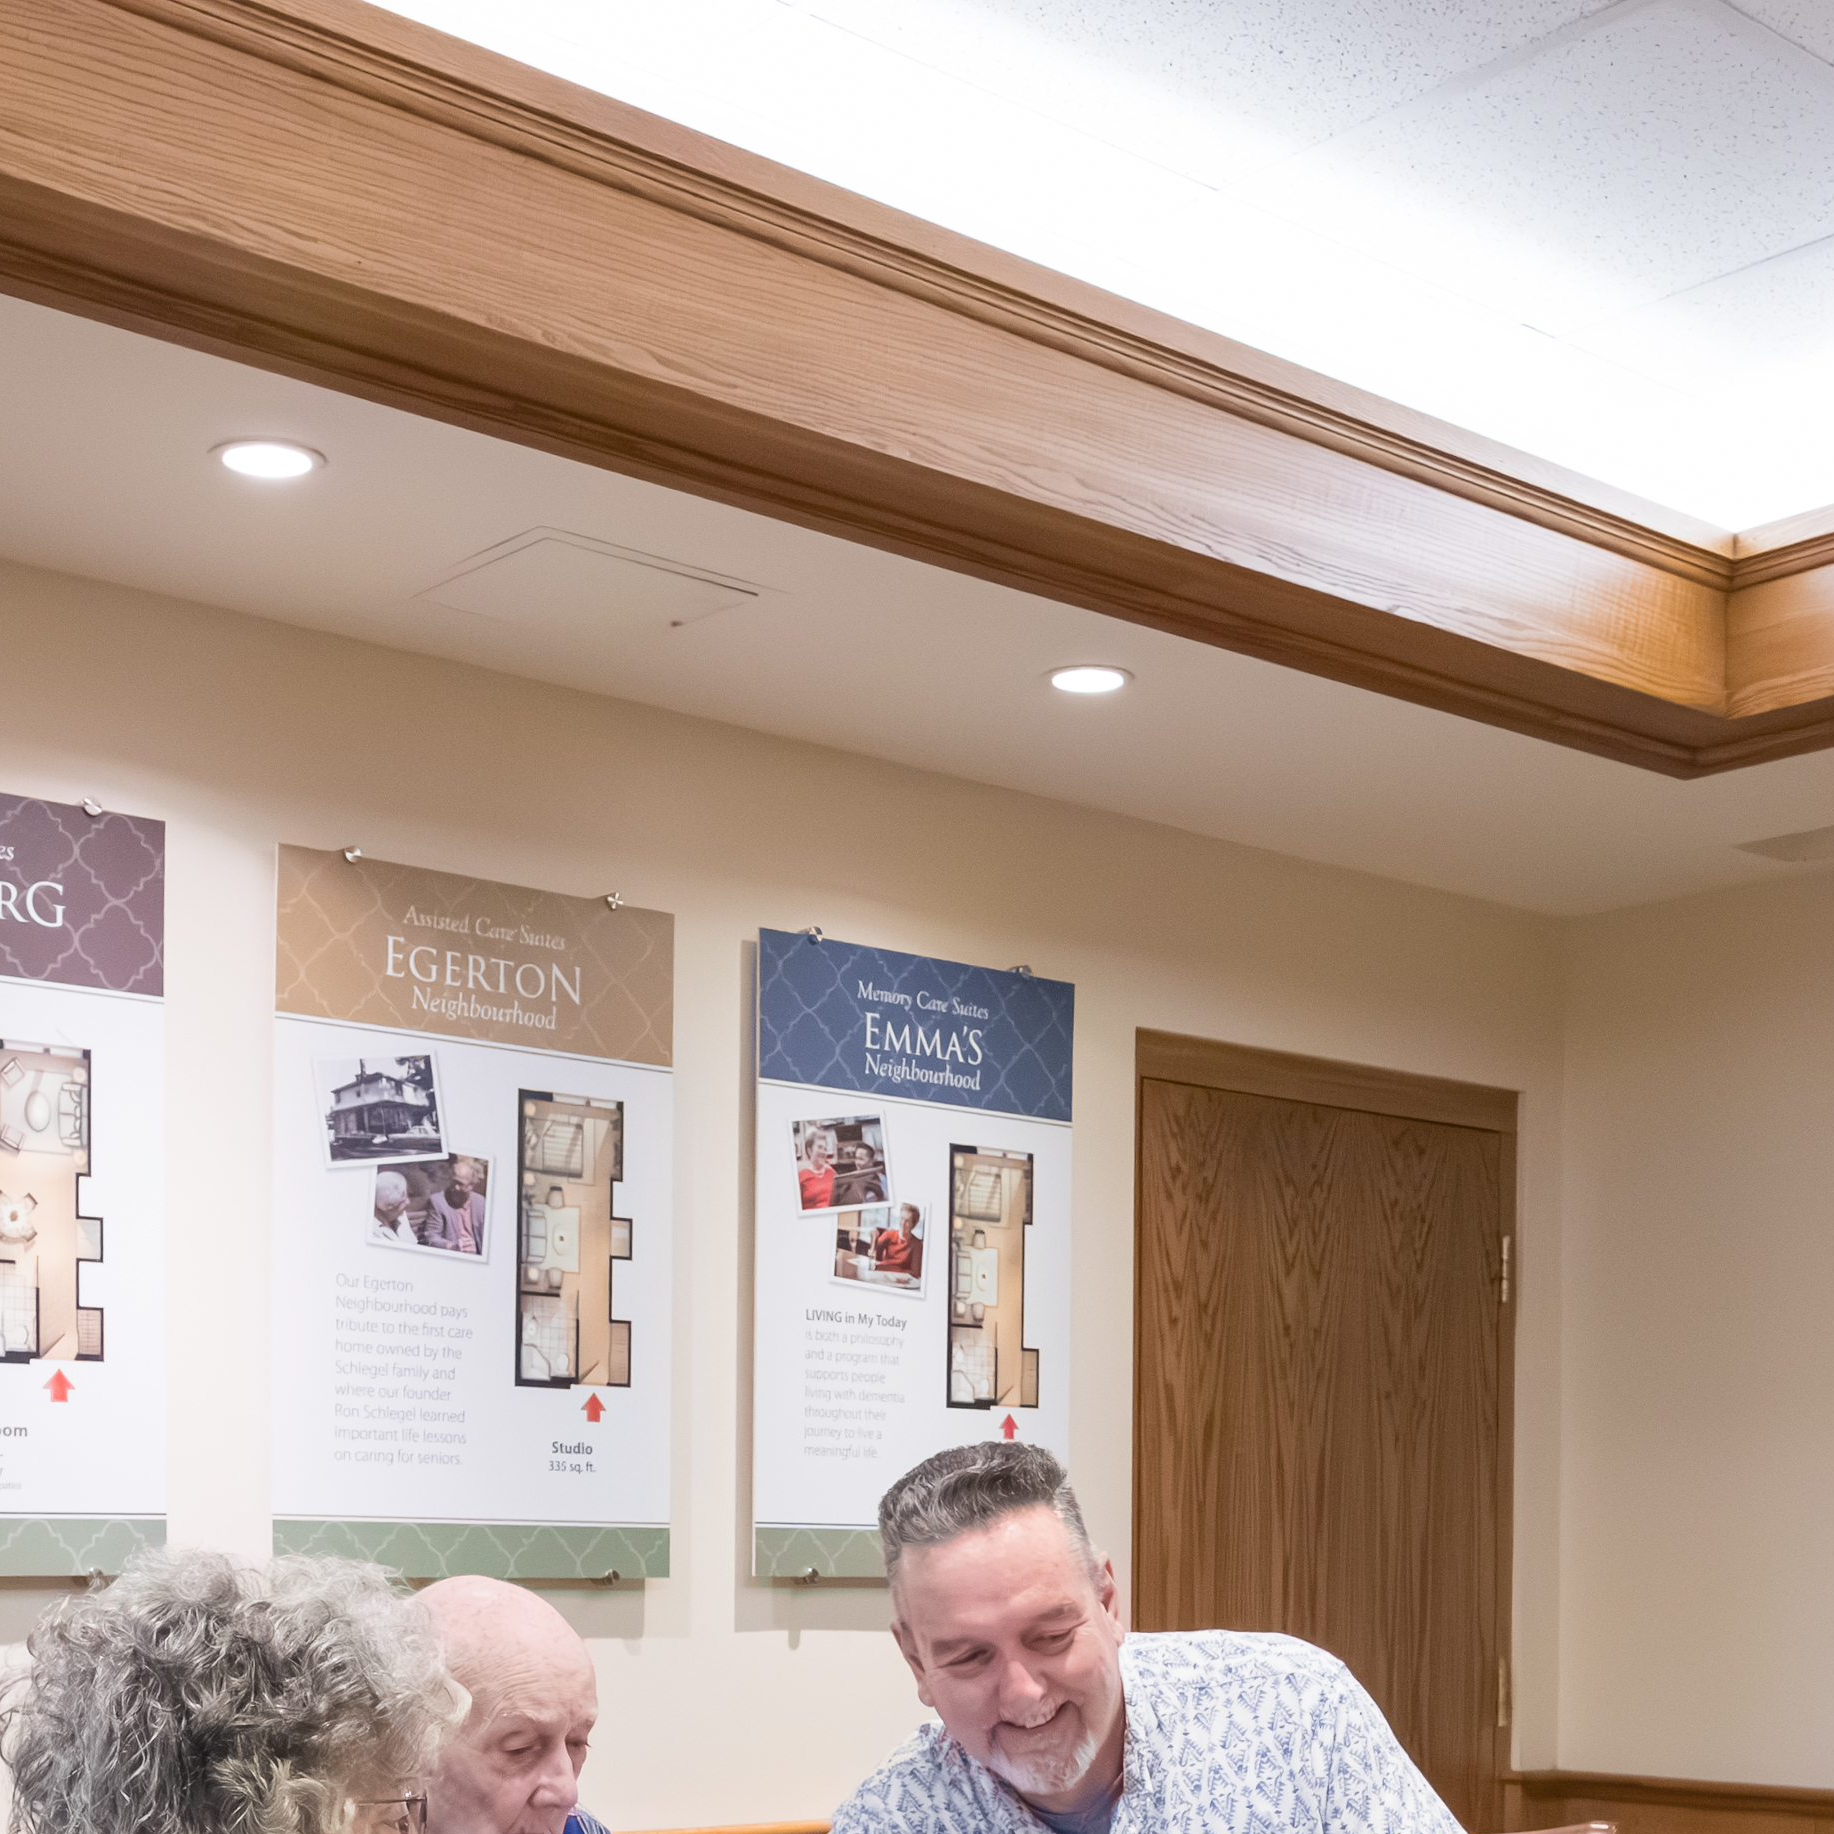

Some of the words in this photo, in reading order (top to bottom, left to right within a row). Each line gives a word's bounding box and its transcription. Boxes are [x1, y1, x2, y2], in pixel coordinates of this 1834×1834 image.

[403, 905, 469, 934] Assisted
[475, 917, 516, 942] Care
[519, 924, 567, 951] Suites
[386, 935, 582, 1006] EGERTON
[412, 986, 557, 1031] Neighbourhood
[857, 980, 913, 1010] Memory
[916, 990, 948, 1013] Care
[952, 997, 990, 1020] Suites
[864, 1011, 984, 1066] EMMA'S
[865, 1052, 982, 1091] Neighbourhood
[336, 1273, 359, 1289] Our
[363, 1275, 413, 1293] Egerton
[335, 1295, 437, 1316] Neighbourhood
[441, 1304, 468, 1321] pays
[336, 1318, 378, 1334] tribute
[382, 1321, 395, 1335] to
[398, 1320, 419, 1336] the
[421, 1322, 445, 1338] first
[447, 1326, 473, 1340] care
[805, 1308, 843, 1324] LIVING
[845, 1311, 855, 1324] in
[857, 1312, 874, 1329] My
[875, 1314, 908, 1331] Today
[804, 1330, 813, 1341] is
[815, 1329, 840, 1344] both
[850, 1331, 905, 1349] philosophy
[335, 1338, 373, 1355] home
[376, 1341, 420, 1358] owned
[423, 1343, 439, 1361] by
[442, 1345, 463, 1360] the
[804, 1348, 825, 1361] and
[835, 1350, 879, 1366] program
[880, 1352, 900, 1366] that
[335, 1360, 389, 1380] Schlegel
[393, 1362, 430, 1382] family
[432, 1367, 456, 1381] and
[804, 1367, 849, 1382] supports
[851, 1370, 886, 1385] people
[335, 1382, 375, 1398] where
[378, 1386, 400, 1399] our
[403, 1385, 452, 1402] founder
[804, 1385, 832, 1402] living
[834, 1388, 856, 1401] with
[858, 1389, 906, 1404] dementia
[334, 1403, 359, 1418] Ron
[363, 1404, 416, 1424] Schlegel
[420, 1406, 465, 1424] learned
[804, 1404, 863, 1422] throughout
[864, 1408, 887, 1422] their
[334, 1425, 398, 1443] important
[401, 1427, 420, 1443] life
[423, 1429, 467, 1445] lessons
[803, 1424, 843, 1441] journey
[844, 1427, 855, 1439] to
[334, 1449, 351, 1462] on
[355, 1448, 394, 1466] caring
[397, 1448, 414, 1464] for
[417, 1451, 464, 1466] seniors.
[551, 1440, 593, 1455] Studio
[803, 1443, 862, 1460] meaningful
[569, 1463, 584, 1475] sq.
[585, 1461, 597, 1473] ft.
